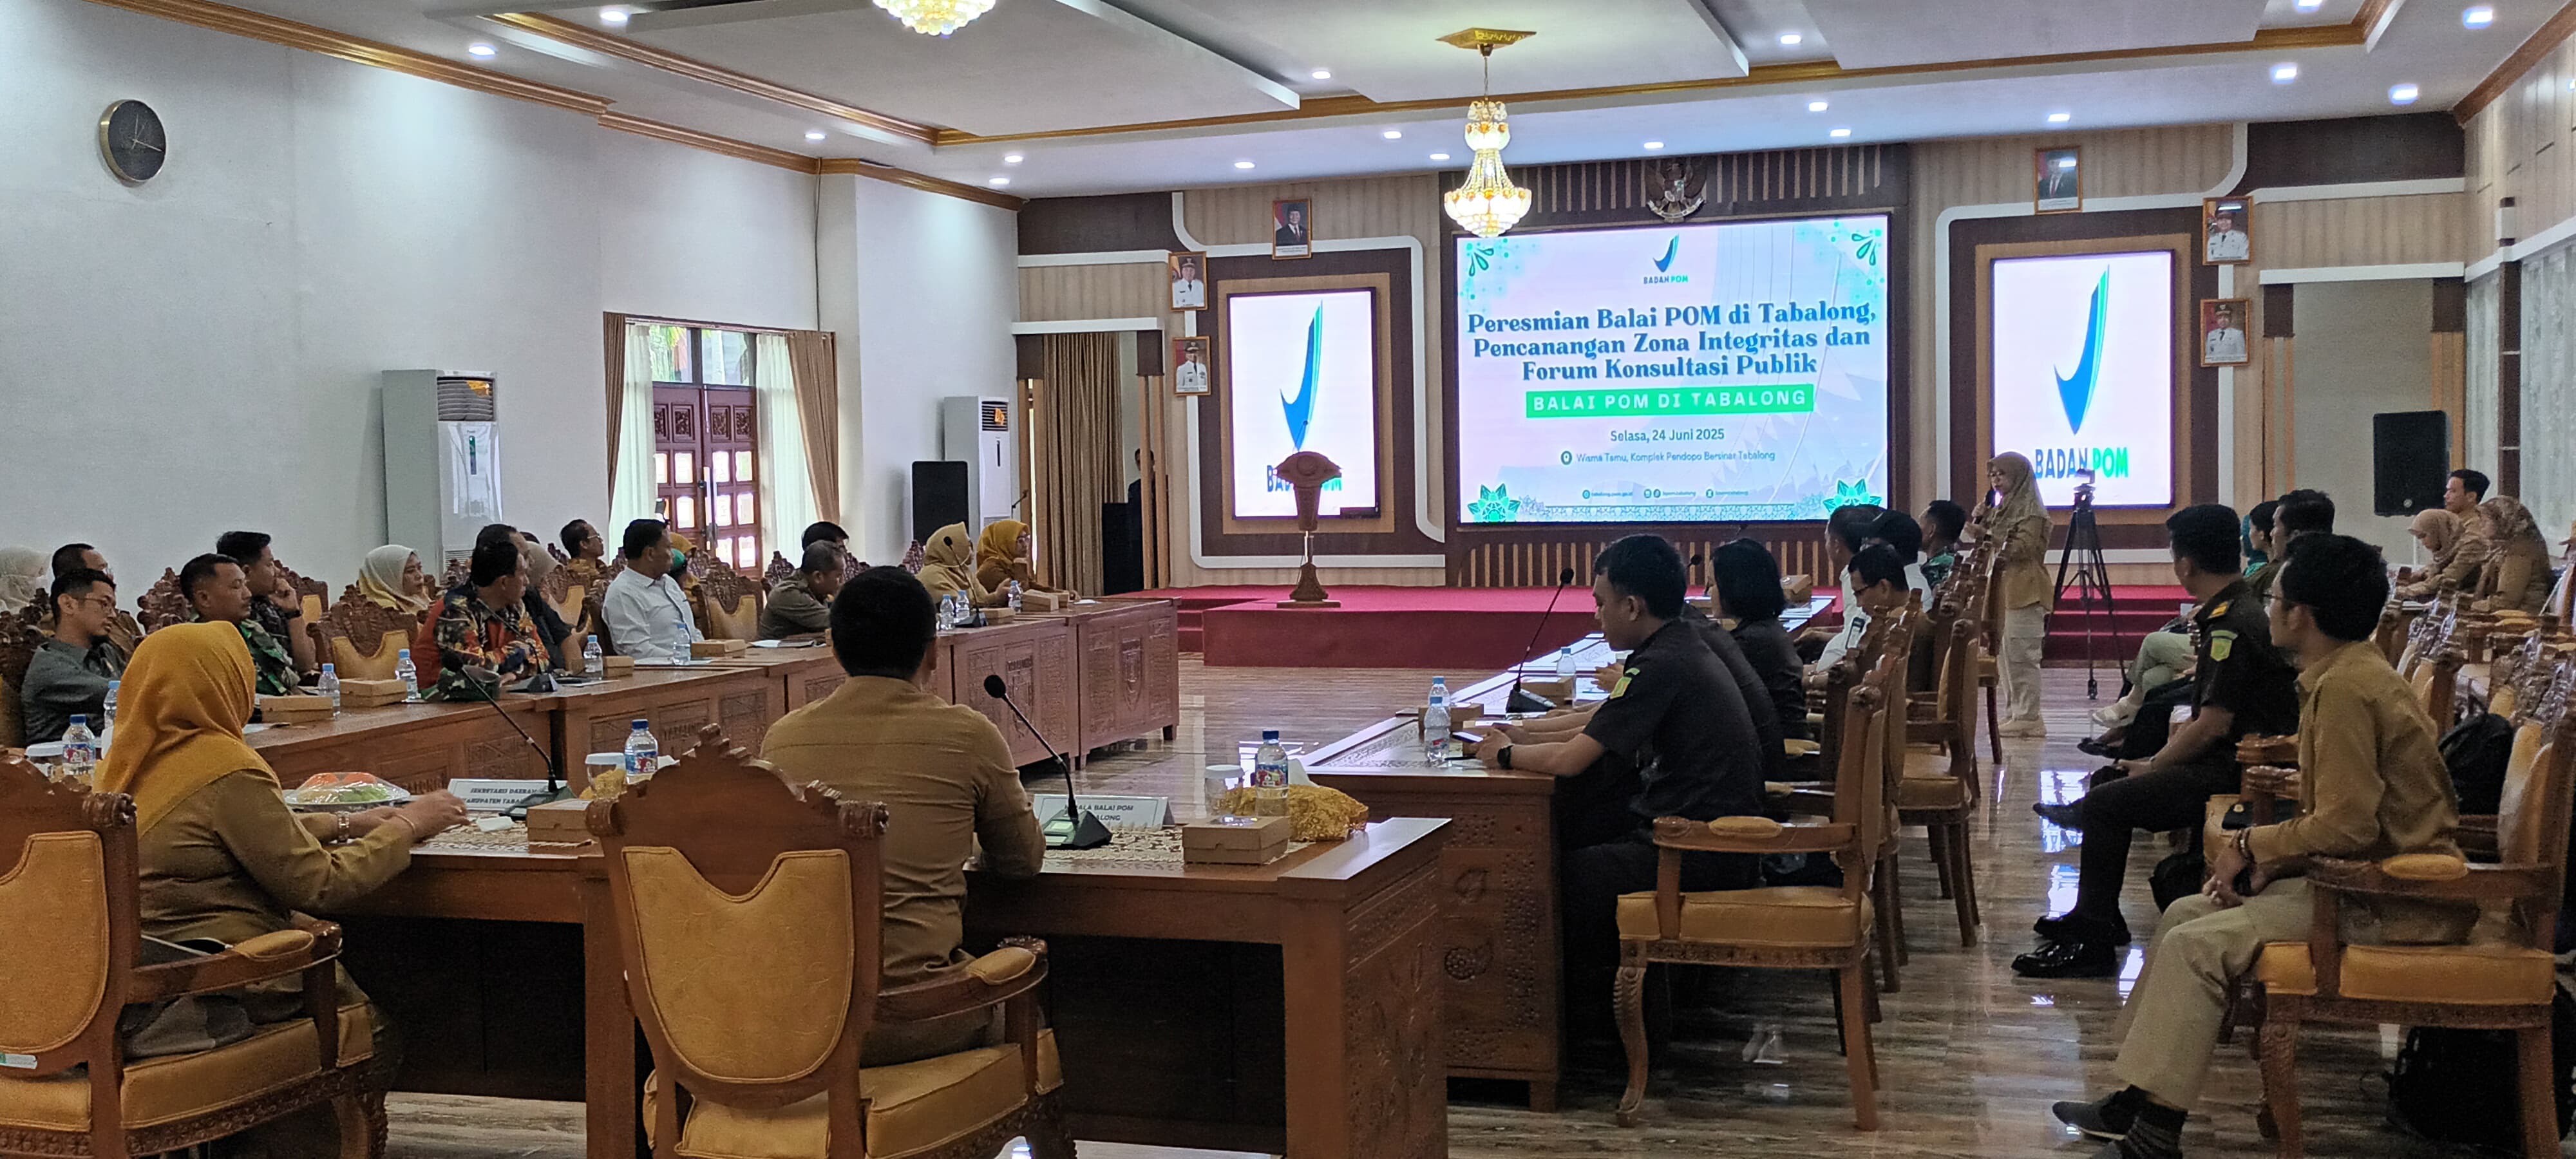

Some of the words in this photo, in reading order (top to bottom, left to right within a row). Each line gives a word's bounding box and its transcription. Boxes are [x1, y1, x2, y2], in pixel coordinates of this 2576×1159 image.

[1643, 276, 1669, 284] BADAN
[1468, 310, 1589, 333] Peresmian
[1597, 307, 1657, 328] Balai
[1665, 305, 1721, 326] POM
[1728, 303, 1750, 325] di
[1758, 301, 1876, 325] Tabalong,
[1474, 338, 1625, 360] Pencanangan
[1634, 333, 1689, 352] Zona
[1698, 328, 1817, 354] Integritas
[1826, 326, 1870, 346] dan
[1522, 361, 1598, 381] Forum
[1605, 355, 1728, 379] Konsultasi
[1736, 352, 1817, 375] Publik
[1533, 395, 1595, 411] BALAI
[1605, 393, 1649, 410] POM
[1658, 393, 1680, 408] DI
[1691, 390, 1806, 407] TABALONG
[1610, 429, 1649, 444] Selasa,
[1652, 429, 1666, 441] 24
[1669, 429, 1694, 440] Juni
[1696, 428, 1725, 440] 2025
[2035, 448, 2088, 478] BADAN
[2093, 447, 2128, 478] POM
